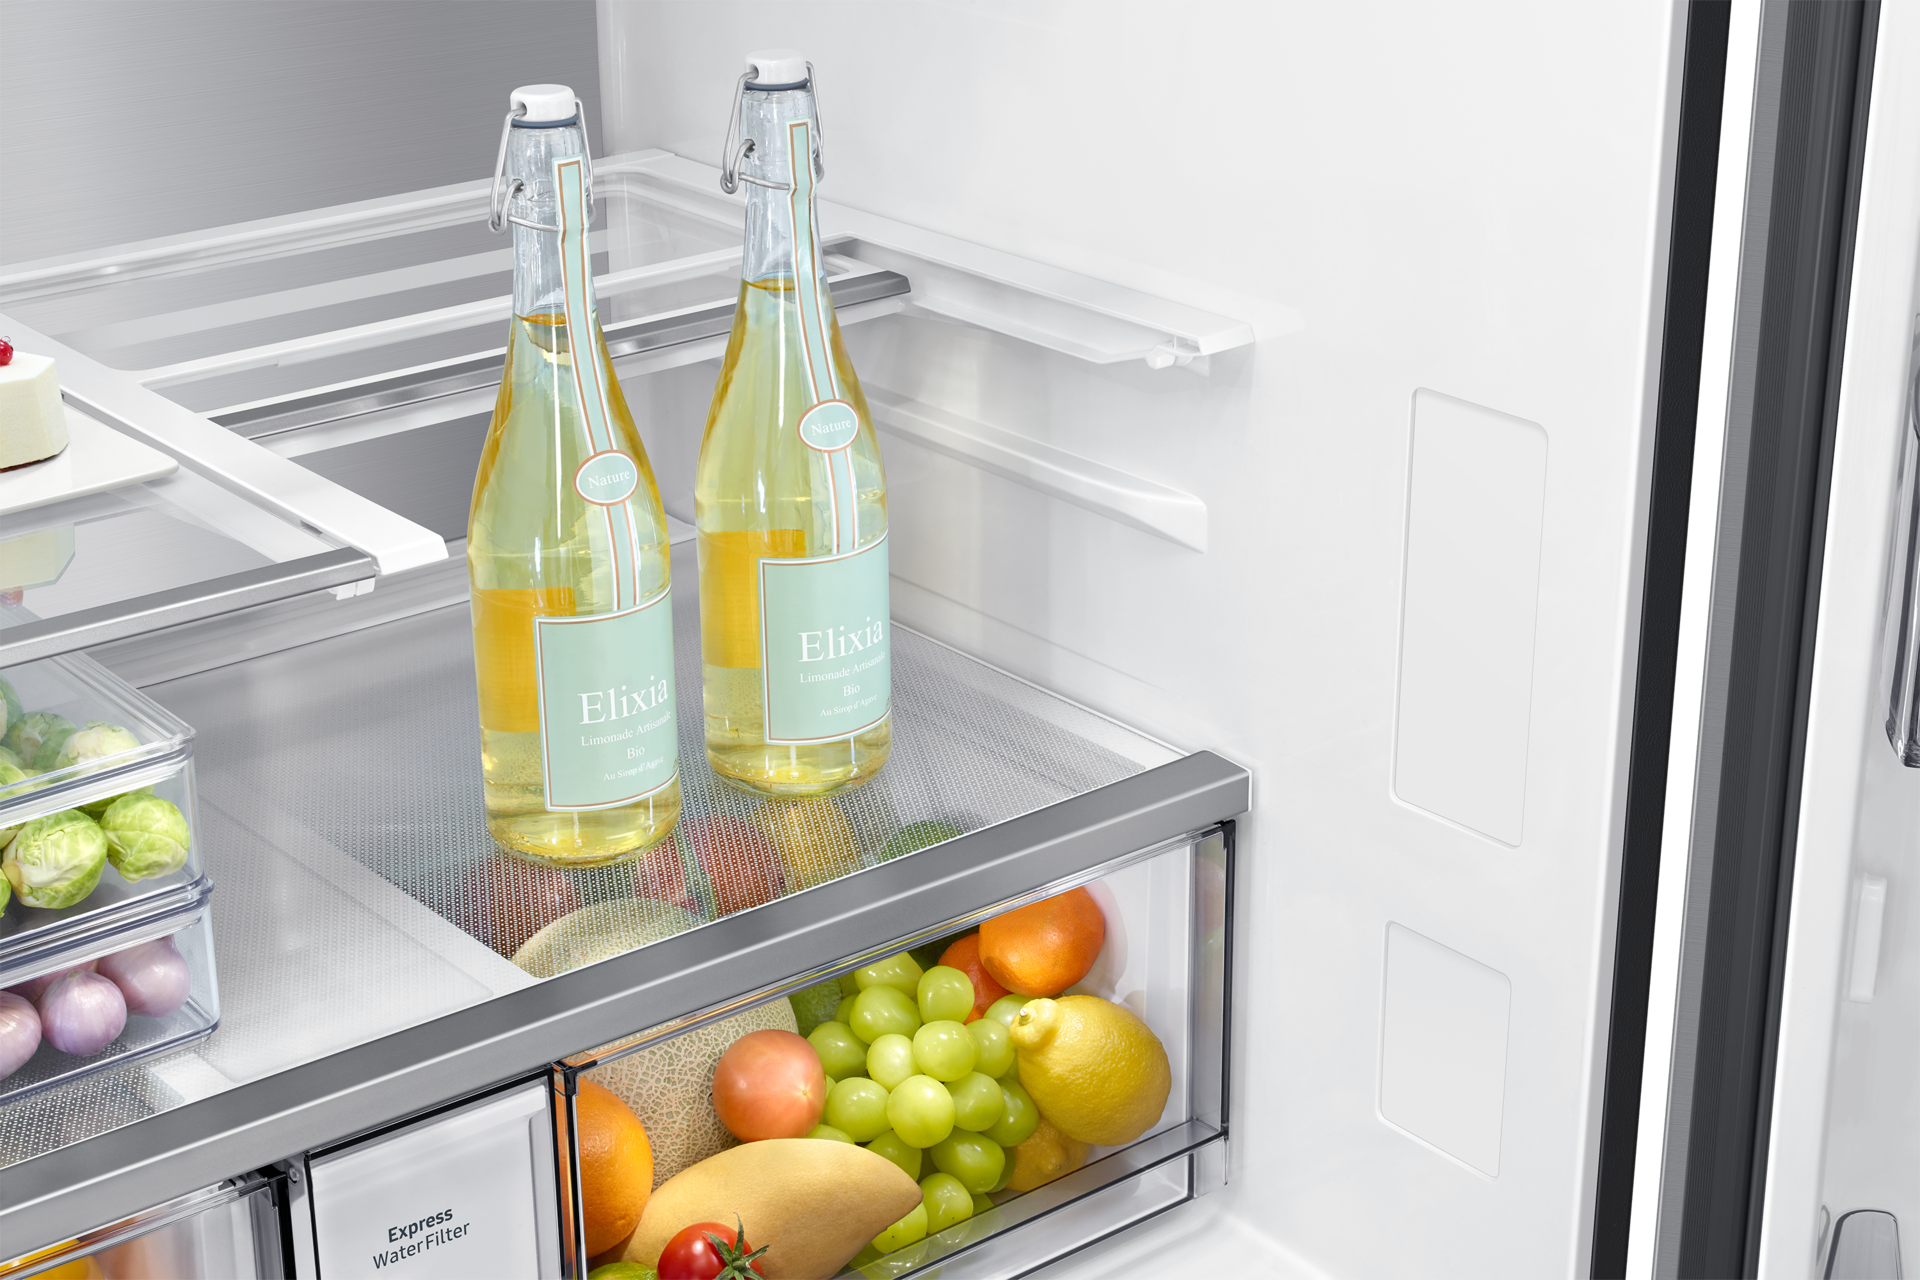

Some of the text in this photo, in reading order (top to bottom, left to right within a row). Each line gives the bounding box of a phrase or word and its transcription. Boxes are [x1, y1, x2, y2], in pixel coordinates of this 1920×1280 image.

[811, 419, 852, 436] Nature
[587, 470, 630, 489] Nature
[797, 616, 884, 663] Elixia
[799, 650, 886, 683] Limonade Artisanale
[842, 683, 861, 697] Bio
[577, 675, 669, 725] Elixia
[819, 708, 832, 717] Au
[833, 705, 853, 715] Sirop
[580, 710, 672, 746] Limonade Artisanale
[626, 745, 646, 759] Bio
[603, 773, 616, 781] Au
[617, 767, 638, 778] Sirop
[387, 1208, 454, 1243] Express
